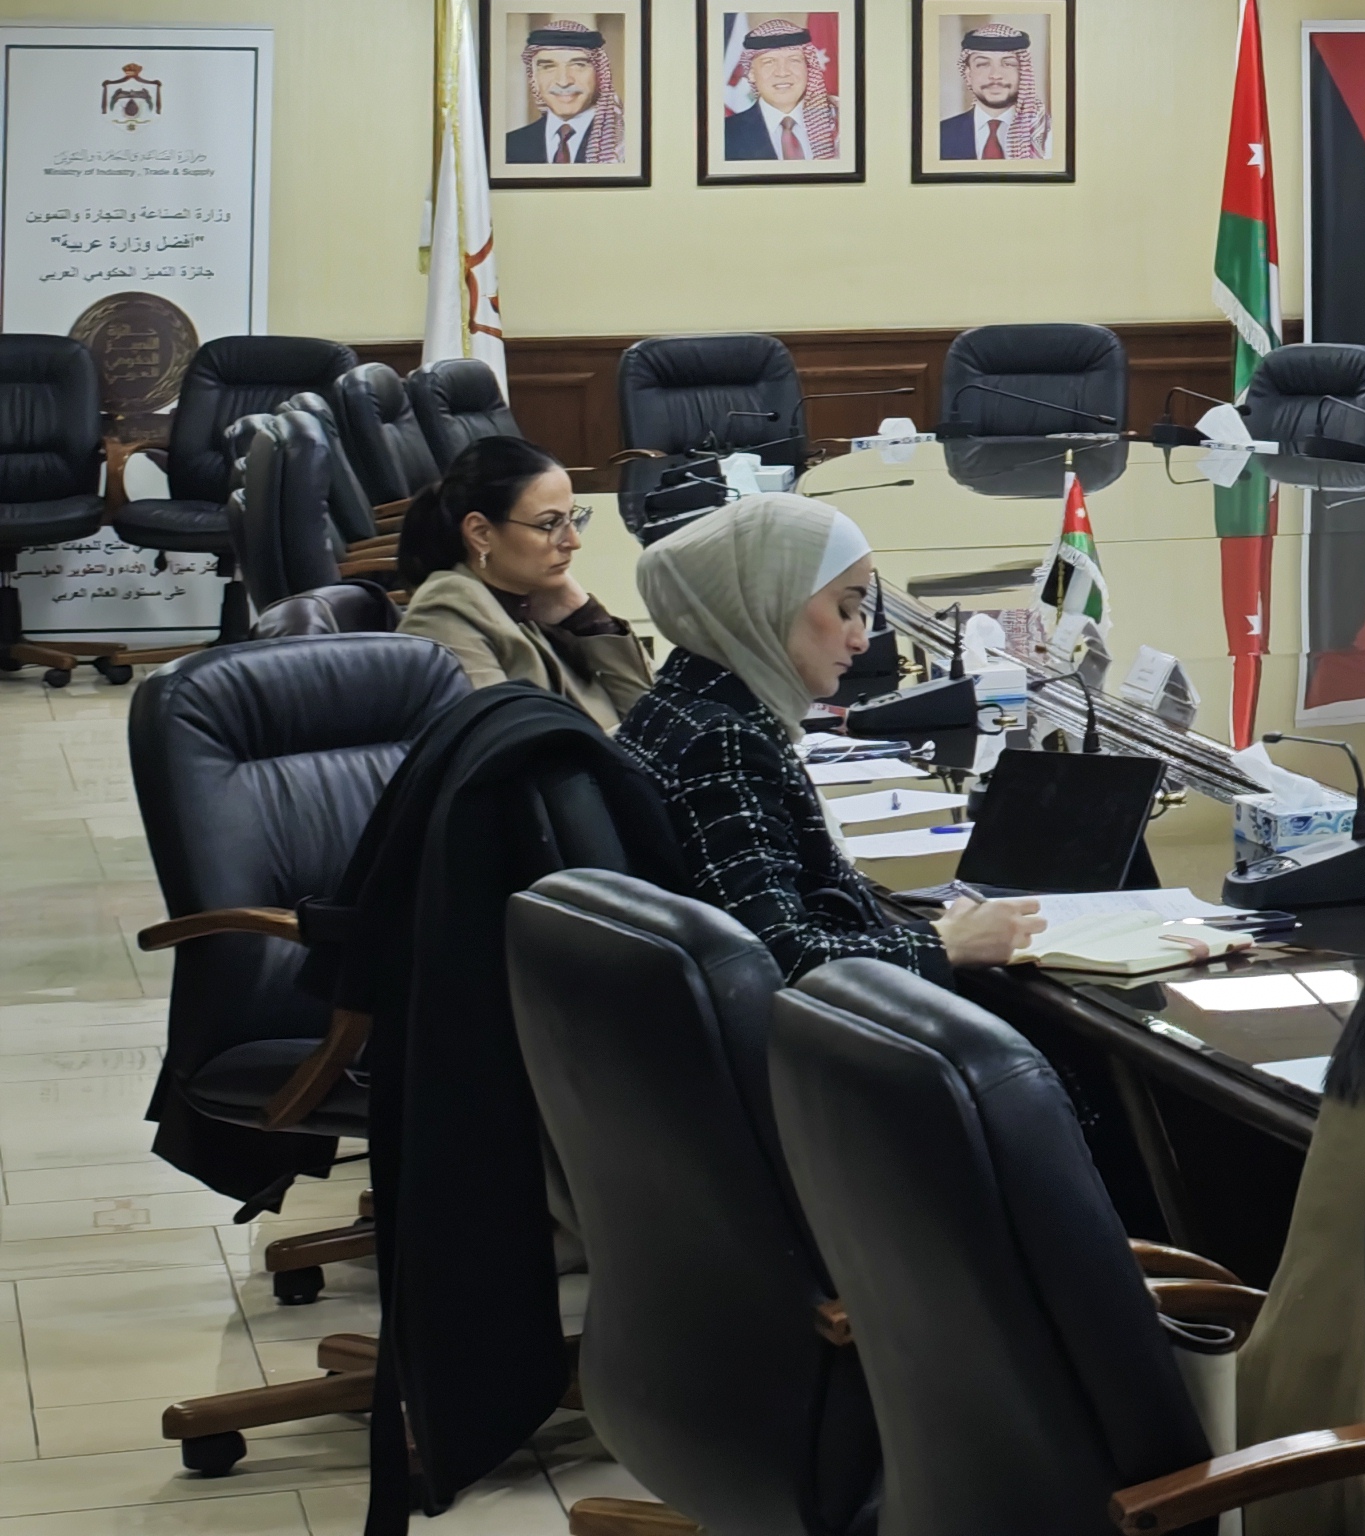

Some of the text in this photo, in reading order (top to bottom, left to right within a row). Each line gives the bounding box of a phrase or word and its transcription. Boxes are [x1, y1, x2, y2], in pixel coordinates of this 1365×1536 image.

[26, 206, 231, 224] وزارة الصناعة والتجارة والتموين
[109, 236, 151, 253] وزارة
[39, 266, 215, 282] جائزة التميز الحكومي العربي
